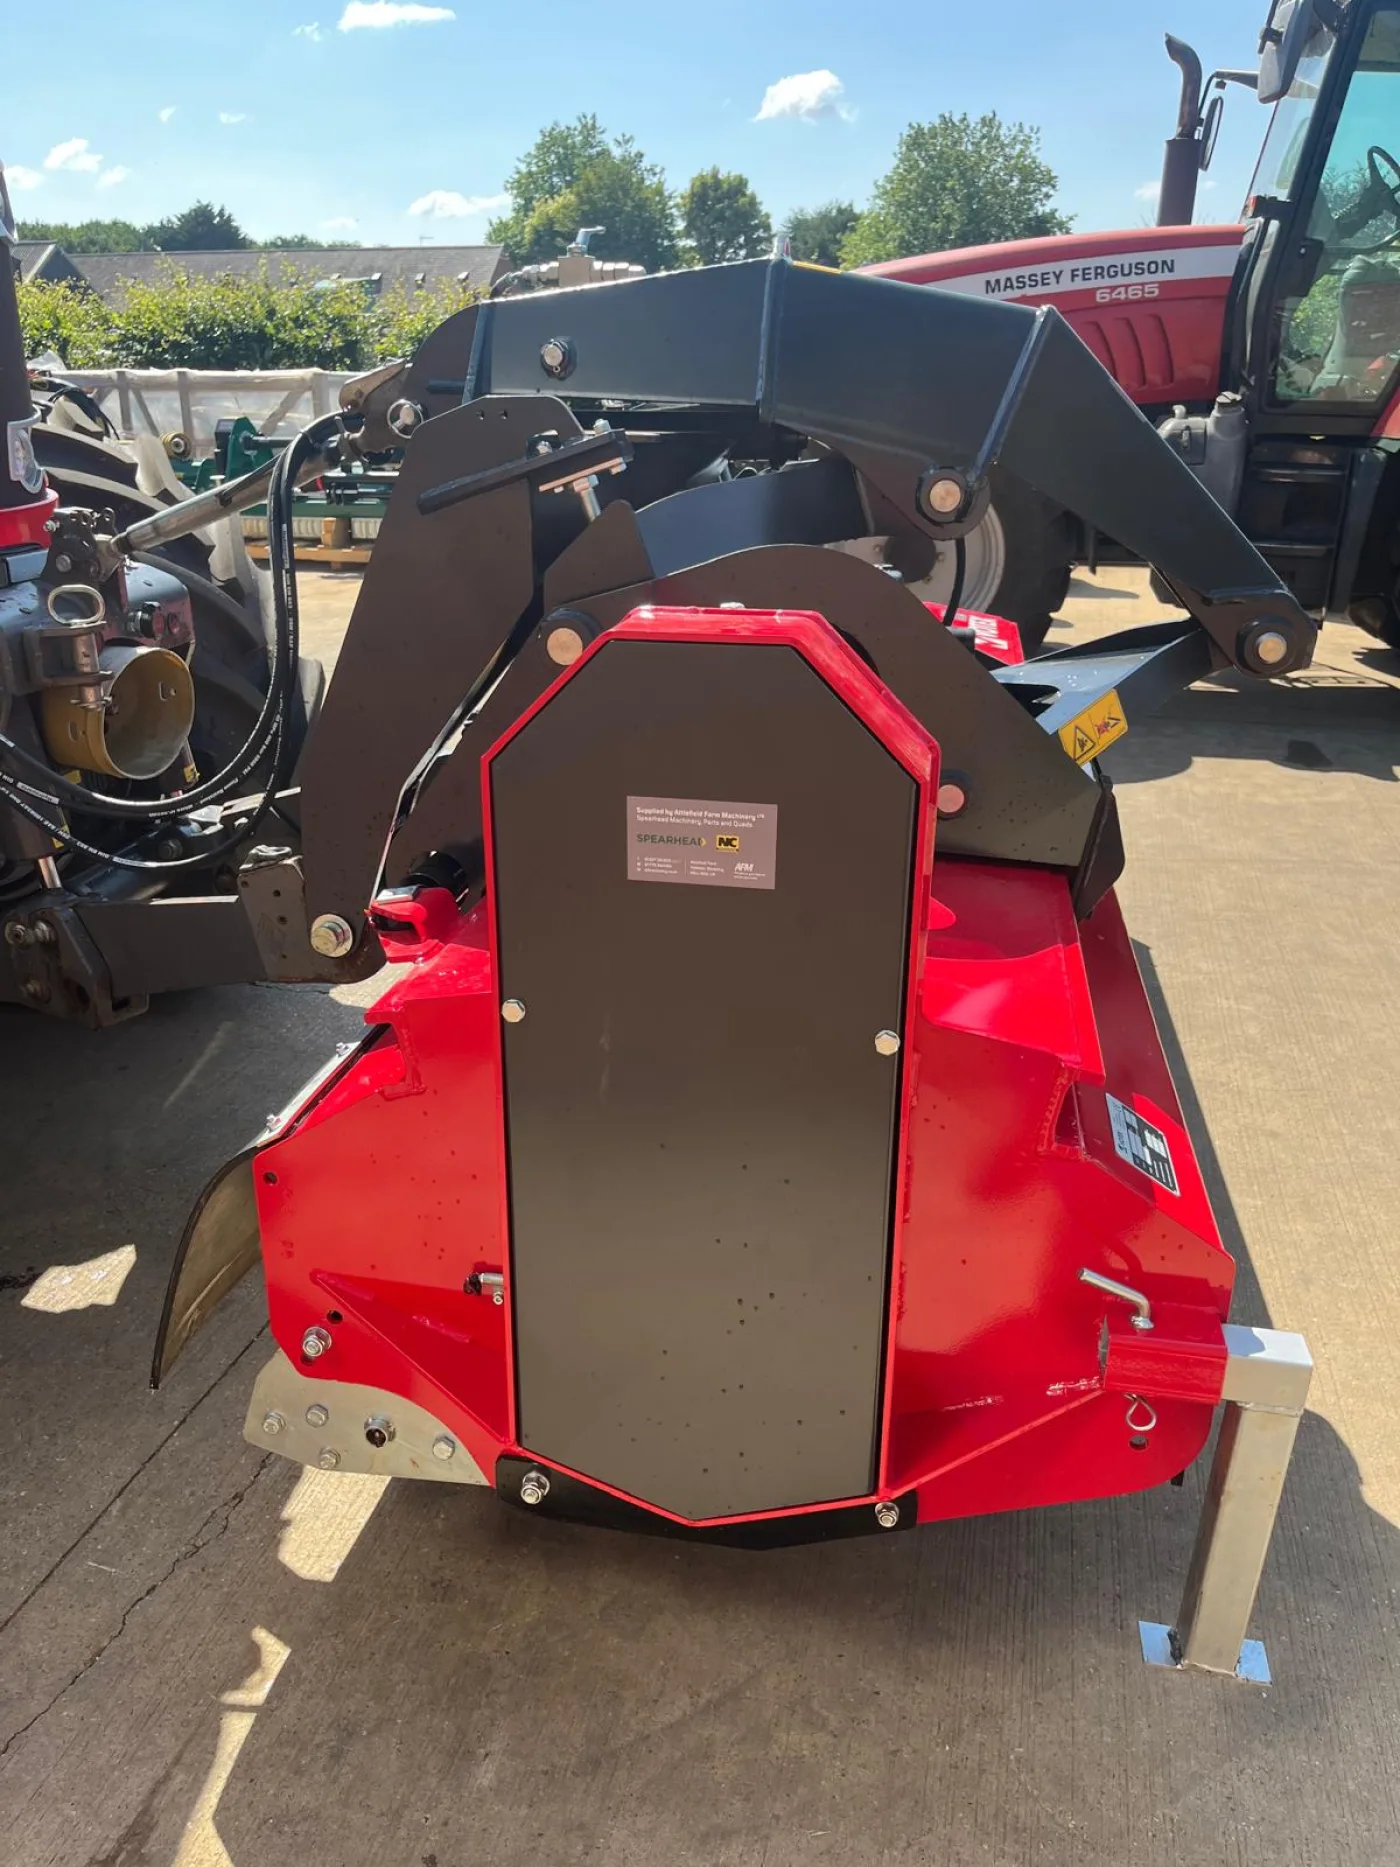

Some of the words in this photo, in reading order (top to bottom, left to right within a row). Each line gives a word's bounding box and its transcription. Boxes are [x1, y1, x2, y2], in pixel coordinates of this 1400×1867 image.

[985, 270, 1064, 294] MASSEY
[1071, 259, 1175, 283] FERGUSON
[1096, 284, 1159, 302] 6465
[637, 807, 664, 816] Supplied
[722, 812, 756, 821] Machinery
[718, 837, 738, 848] NC
[734, 862, 754, 872] AFM
